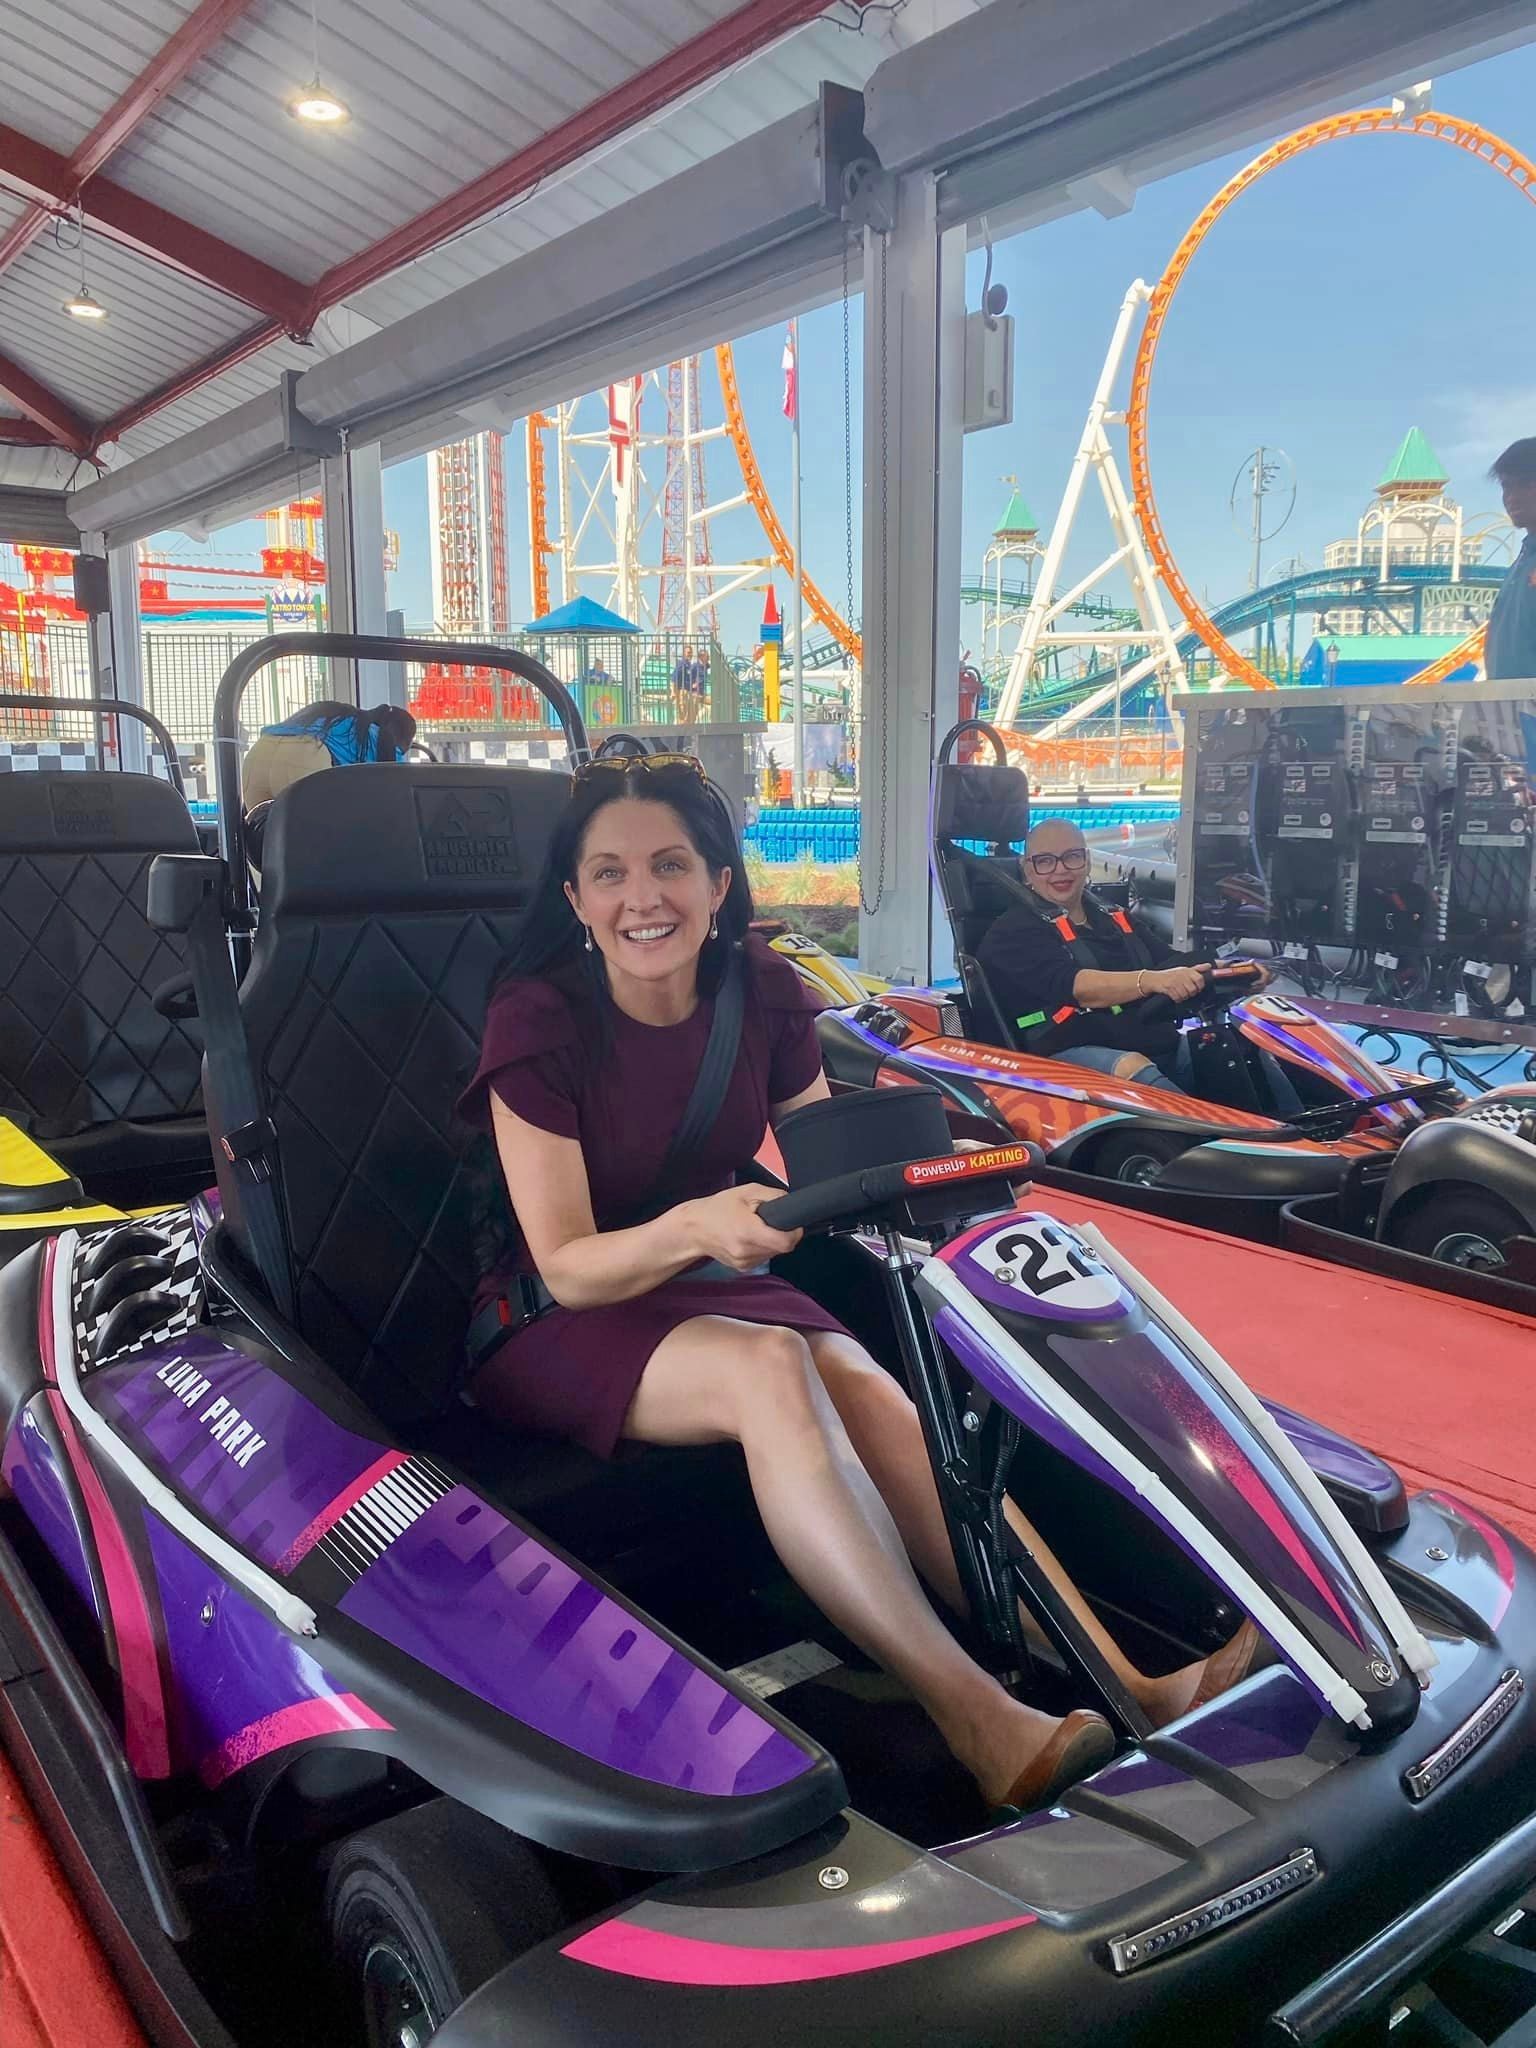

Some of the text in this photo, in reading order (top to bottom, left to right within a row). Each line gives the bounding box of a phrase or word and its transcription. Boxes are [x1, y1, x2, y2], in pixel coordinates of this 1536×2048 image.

[940, 1044, 1020, 1070] LUNA PARK
[969, 1149, 1023, 1169] KARTING
[156, 1356, 267, 1468] LUNA PARK
